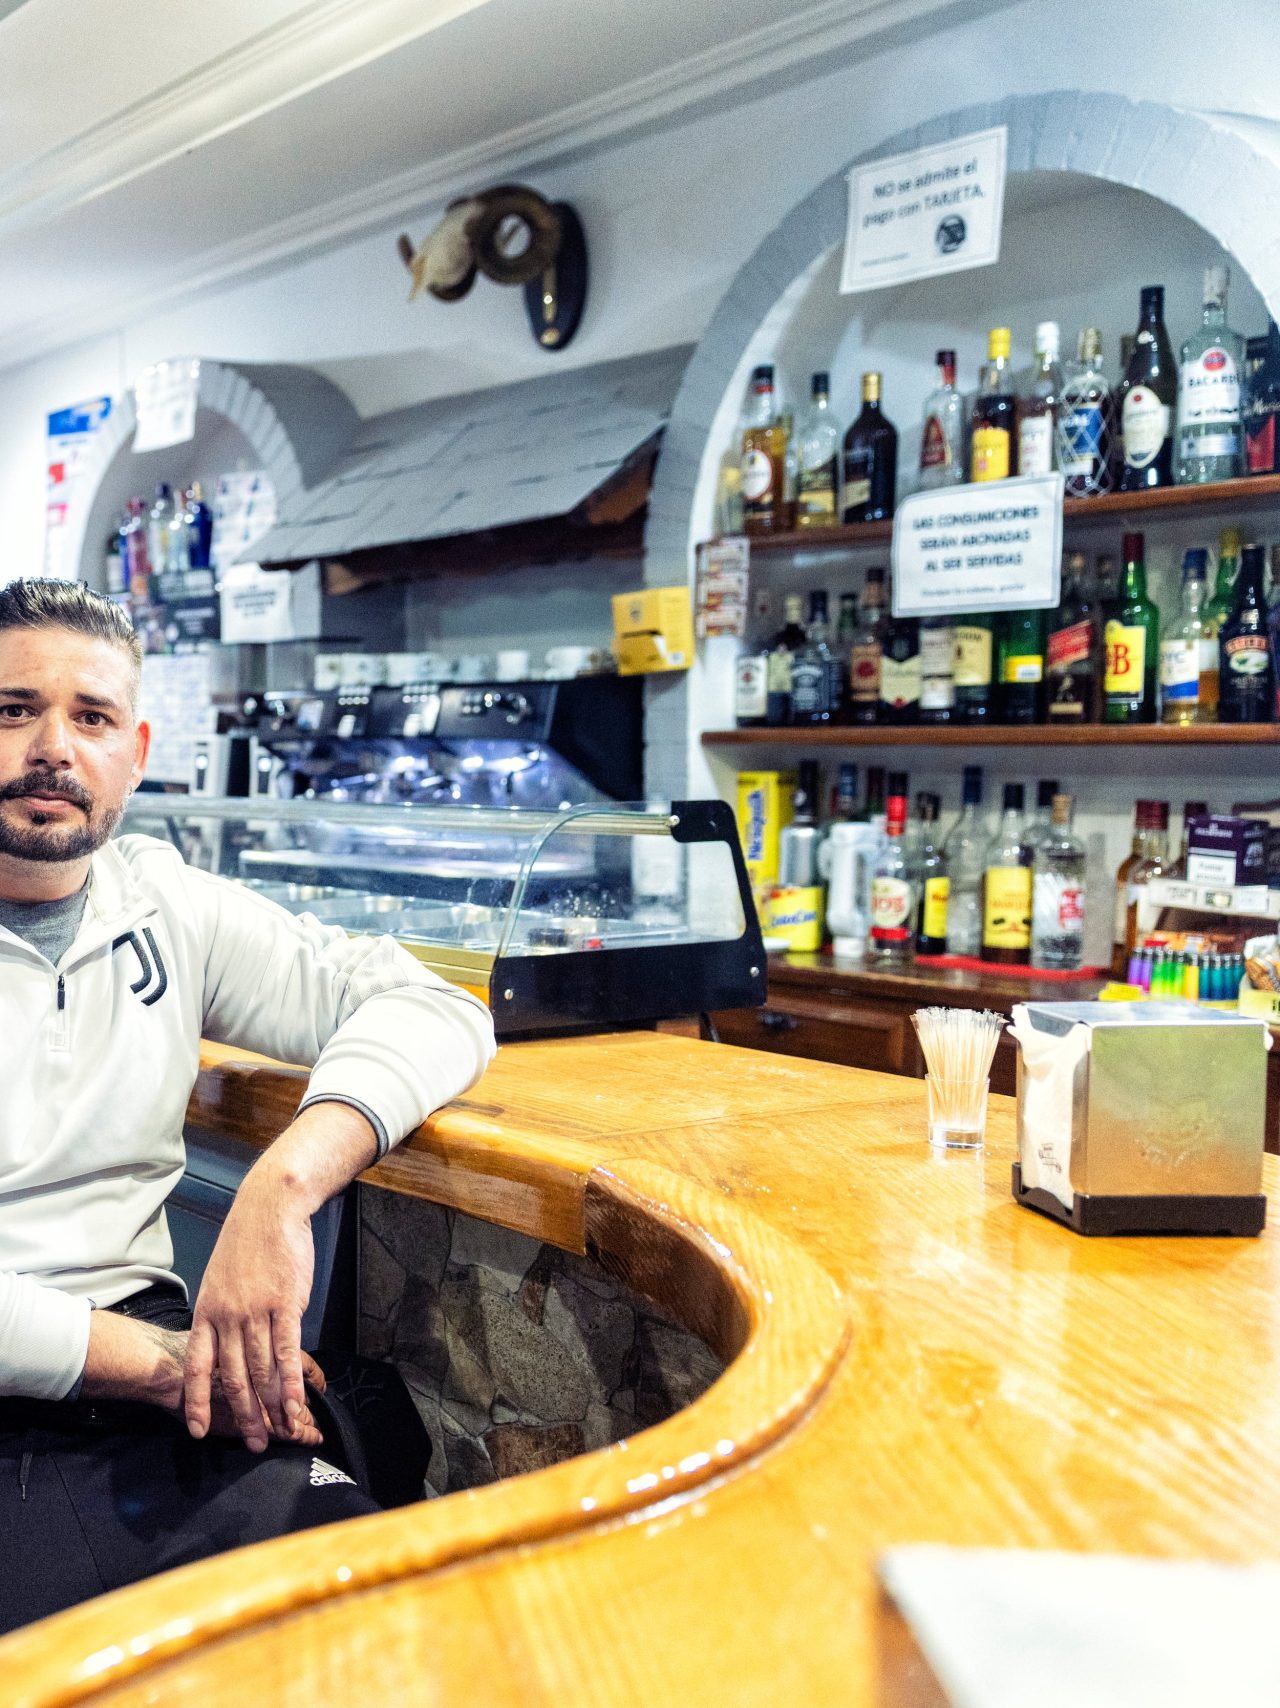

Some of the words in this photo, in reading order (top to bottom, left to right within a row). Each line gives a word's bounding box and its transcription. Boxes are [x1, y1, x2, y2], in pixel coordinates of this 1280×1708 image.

[873, 180, 896, 198] NO
[897, 179, 912, 193] se
[914, 166, 960, 188] admite
[963, 157, 977, 173] el
[863, 208, 896, 229] pago
[897, 202, 921, 217] con
[913, 517, 933, 530] LAS
[938, 506, 1040, 527] CONSUMICIONES
[962, 529, 1032, 546] ABONADAS
[924, 560, 938, 571] AL
[943, 557, 962, 570] SER
[967, 552, 1024, 568] SERVIDAS
